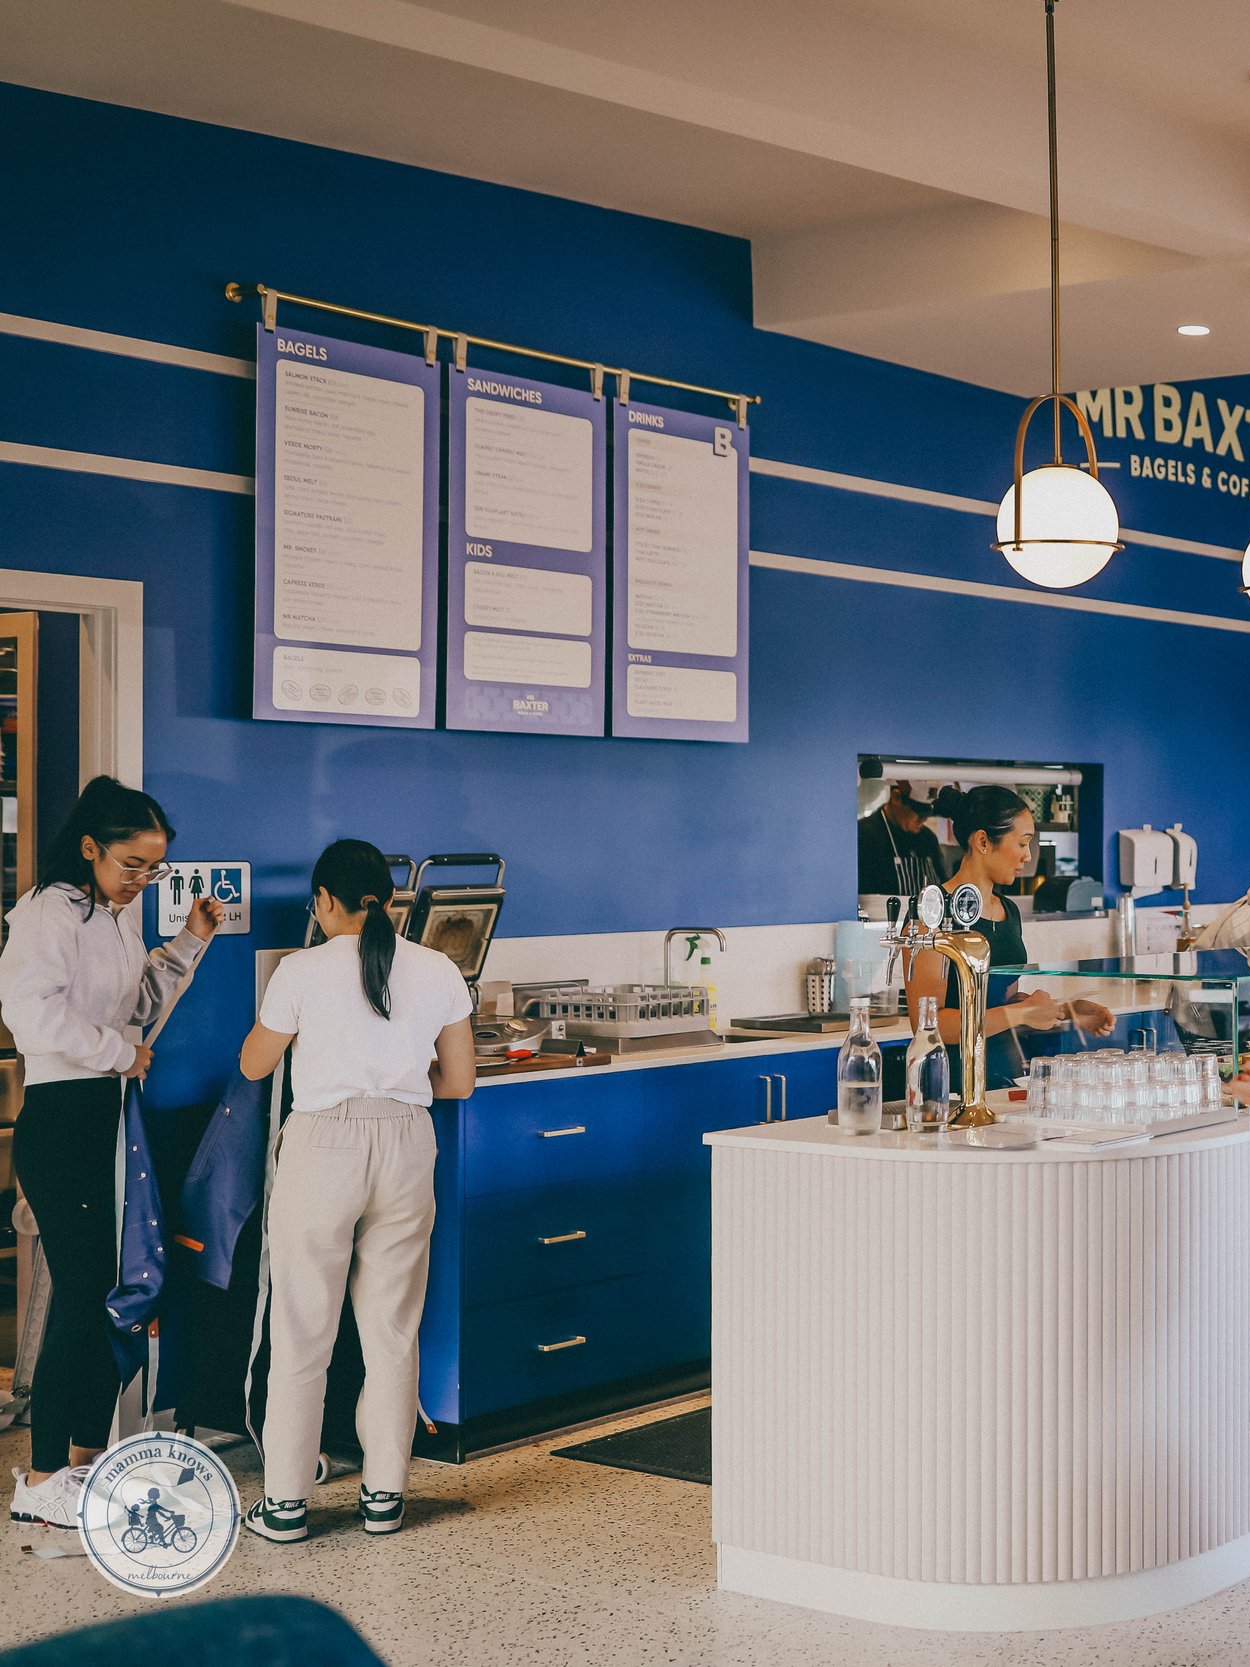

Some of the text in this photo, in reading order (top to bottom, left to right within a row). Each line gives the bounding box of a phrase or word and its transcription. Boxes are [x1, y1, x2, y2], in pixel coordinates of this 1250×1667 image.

[277, 338, 328, 361] BAGELS
[467, 377, 543, 404] SANDWICHES
[628, 410, 664, 429] DRINKS
[1076, 384, 1146, 440] MR
[715, 426, 733, 457] B
[1130, 454, 1195, 485] BAGELS
[1201, 467, 1213, 488] &
[466, 542, 493, 558] KIDS
[628, 653, 652, 663] EXTRAS
[513, 699, 549, 711] BAXTER
[229, 912, 242, 921] LH
[284, 1500, 299, 1509] NIKE
